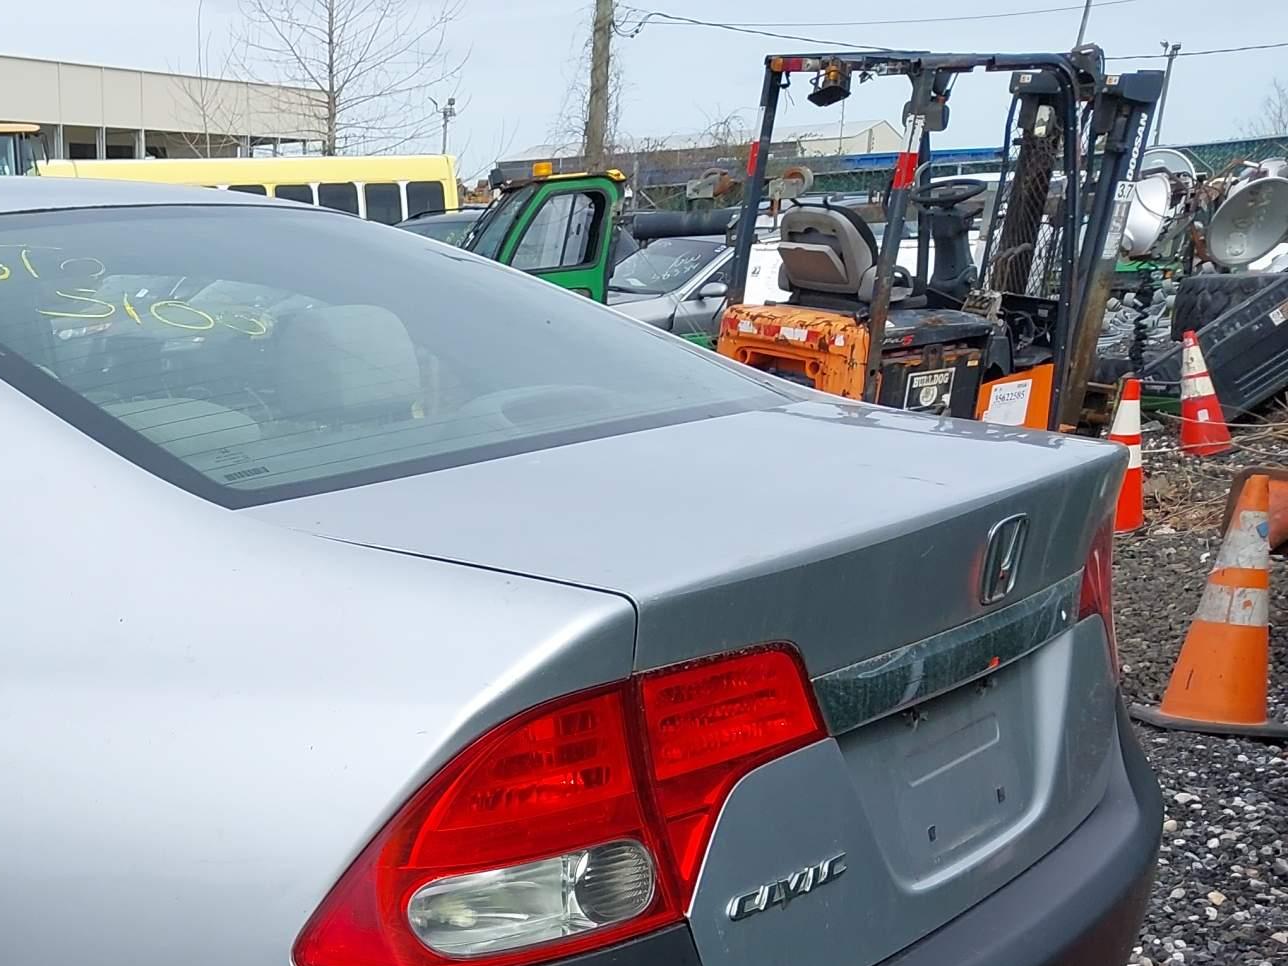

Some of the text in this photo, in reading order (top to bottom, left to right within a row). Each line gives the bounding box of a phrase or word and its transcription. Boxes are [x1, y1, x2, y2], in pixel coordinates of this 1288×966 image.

[1126, 112, 1148, 181] DOOSAN
[911, 371, 951, 388] BULLDOG
[725, 851, 848, 921] CIVIC
